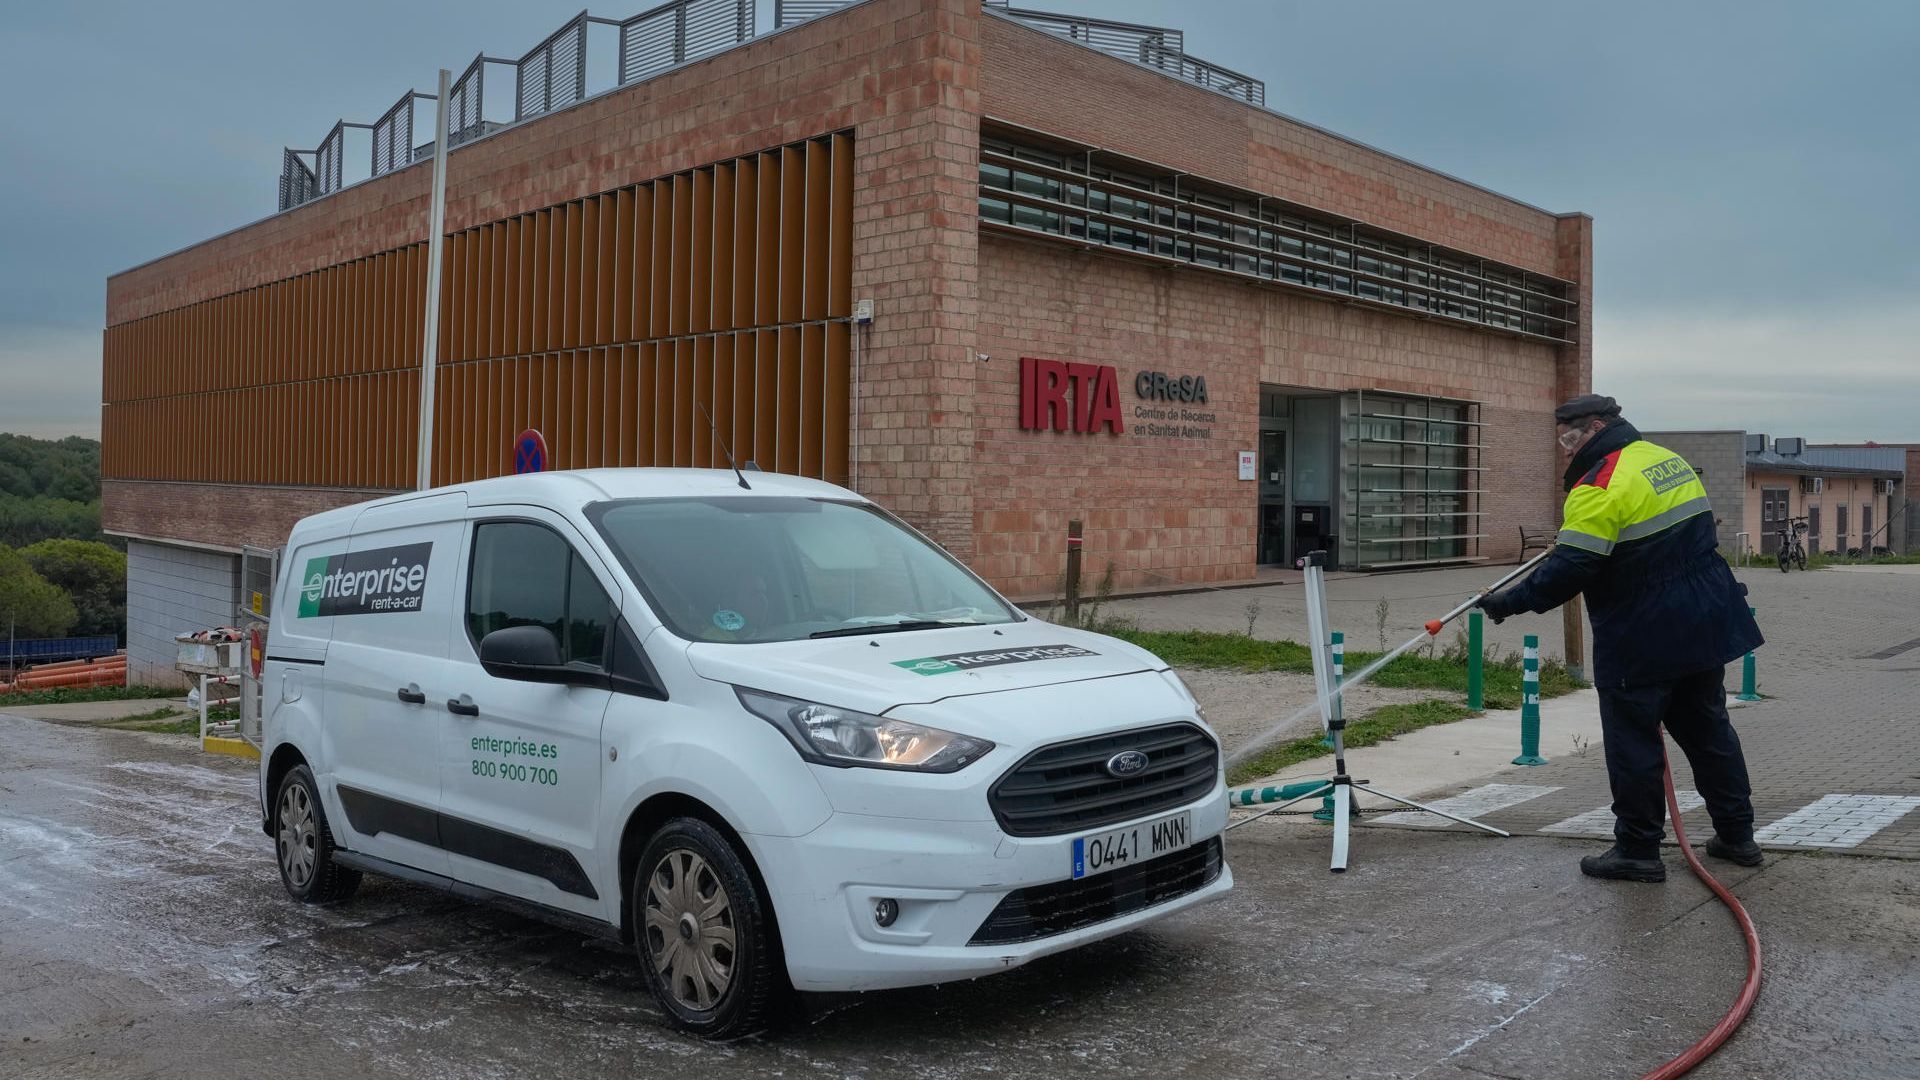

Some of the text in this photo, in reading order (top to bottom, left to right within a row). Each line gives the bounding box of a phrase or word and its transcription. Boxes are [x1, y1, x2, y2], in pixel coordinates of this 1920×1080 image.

[1019, 357, 1125, 434] IRTA
[1135, 370, 1209, 404] CReSA
[1134, 405, 1216, 424] Centre de Recerca
[1134, 423, 1211, 439] en Sanitat Animal
[1644, 458, 1690, 484] POLICIA
[301, 557, 425, 605] enterprise
[371, 595, 421, 610] rent-a-car
[908, 647, 1086, 671] enterprise
[471, 735, 558, 759] enterprise.es
[471, 759, 558, 786] 800 900 700
[1119, 754, 1142, 772] Ford
[1089, 816, 1185, 869] 0441 MNN
[1076, 862, 1082, 872] E
